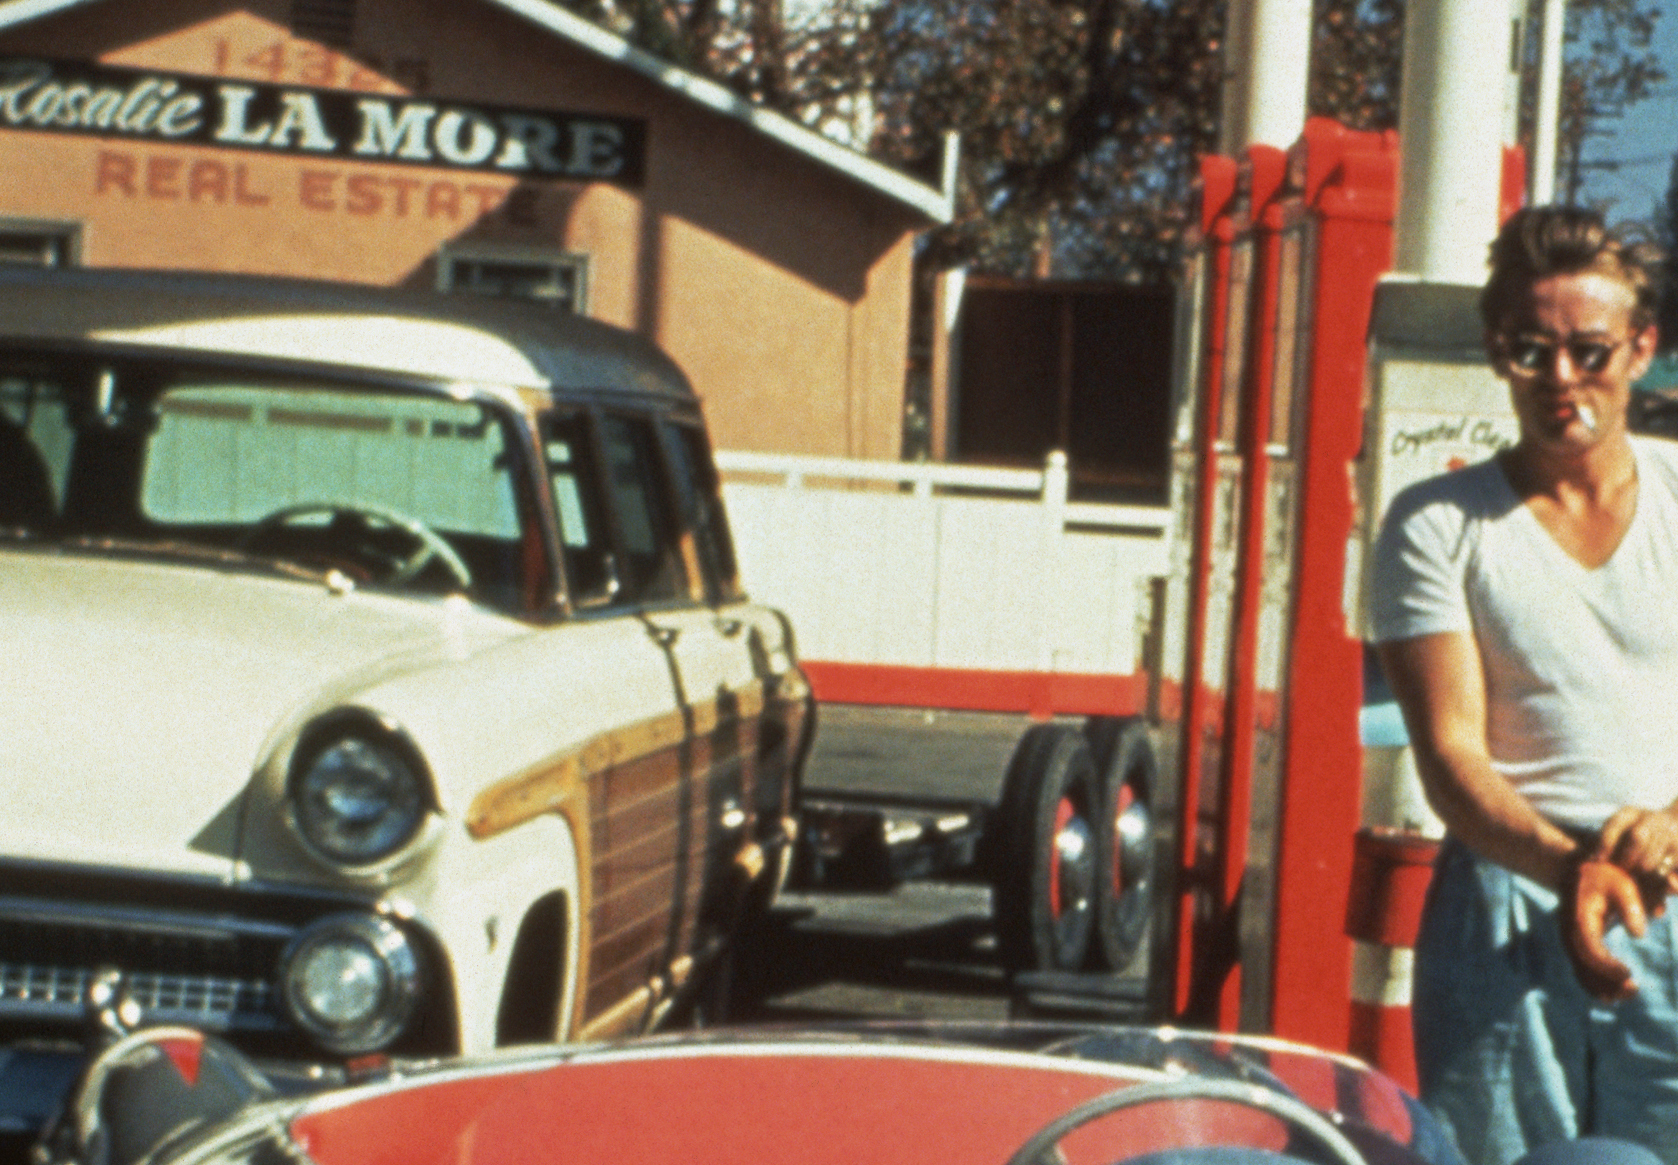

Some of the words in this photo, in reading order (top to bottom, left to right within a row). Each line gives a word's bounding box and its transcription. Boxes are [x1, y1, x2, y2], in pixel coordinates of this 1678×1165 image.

[213, 86, 337, 151] LA
[353, 100, 624, 177] MORE
[97, 149, 269, 207] REAL
[300, 170, 536, 228] ESTATE
